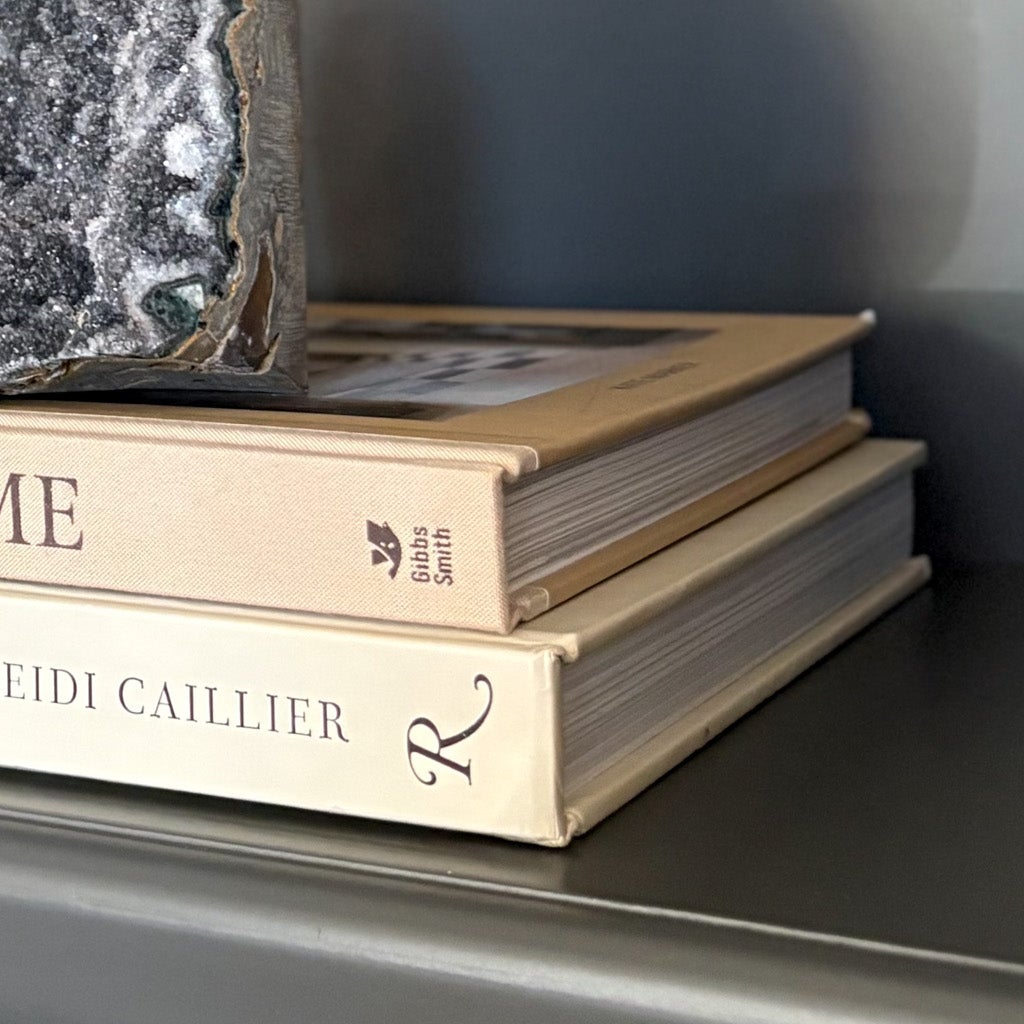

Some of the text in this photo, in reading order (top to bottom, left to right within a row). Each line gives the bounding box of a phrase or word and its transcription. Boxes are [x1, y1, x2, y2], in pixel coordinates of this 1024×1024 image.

[409, 526, 431, 584] Gibbs
[433, 527, 454, 587] Smith
[118, 675, 350, 744] CAILLIER
[406, 673, 494, 787] R
